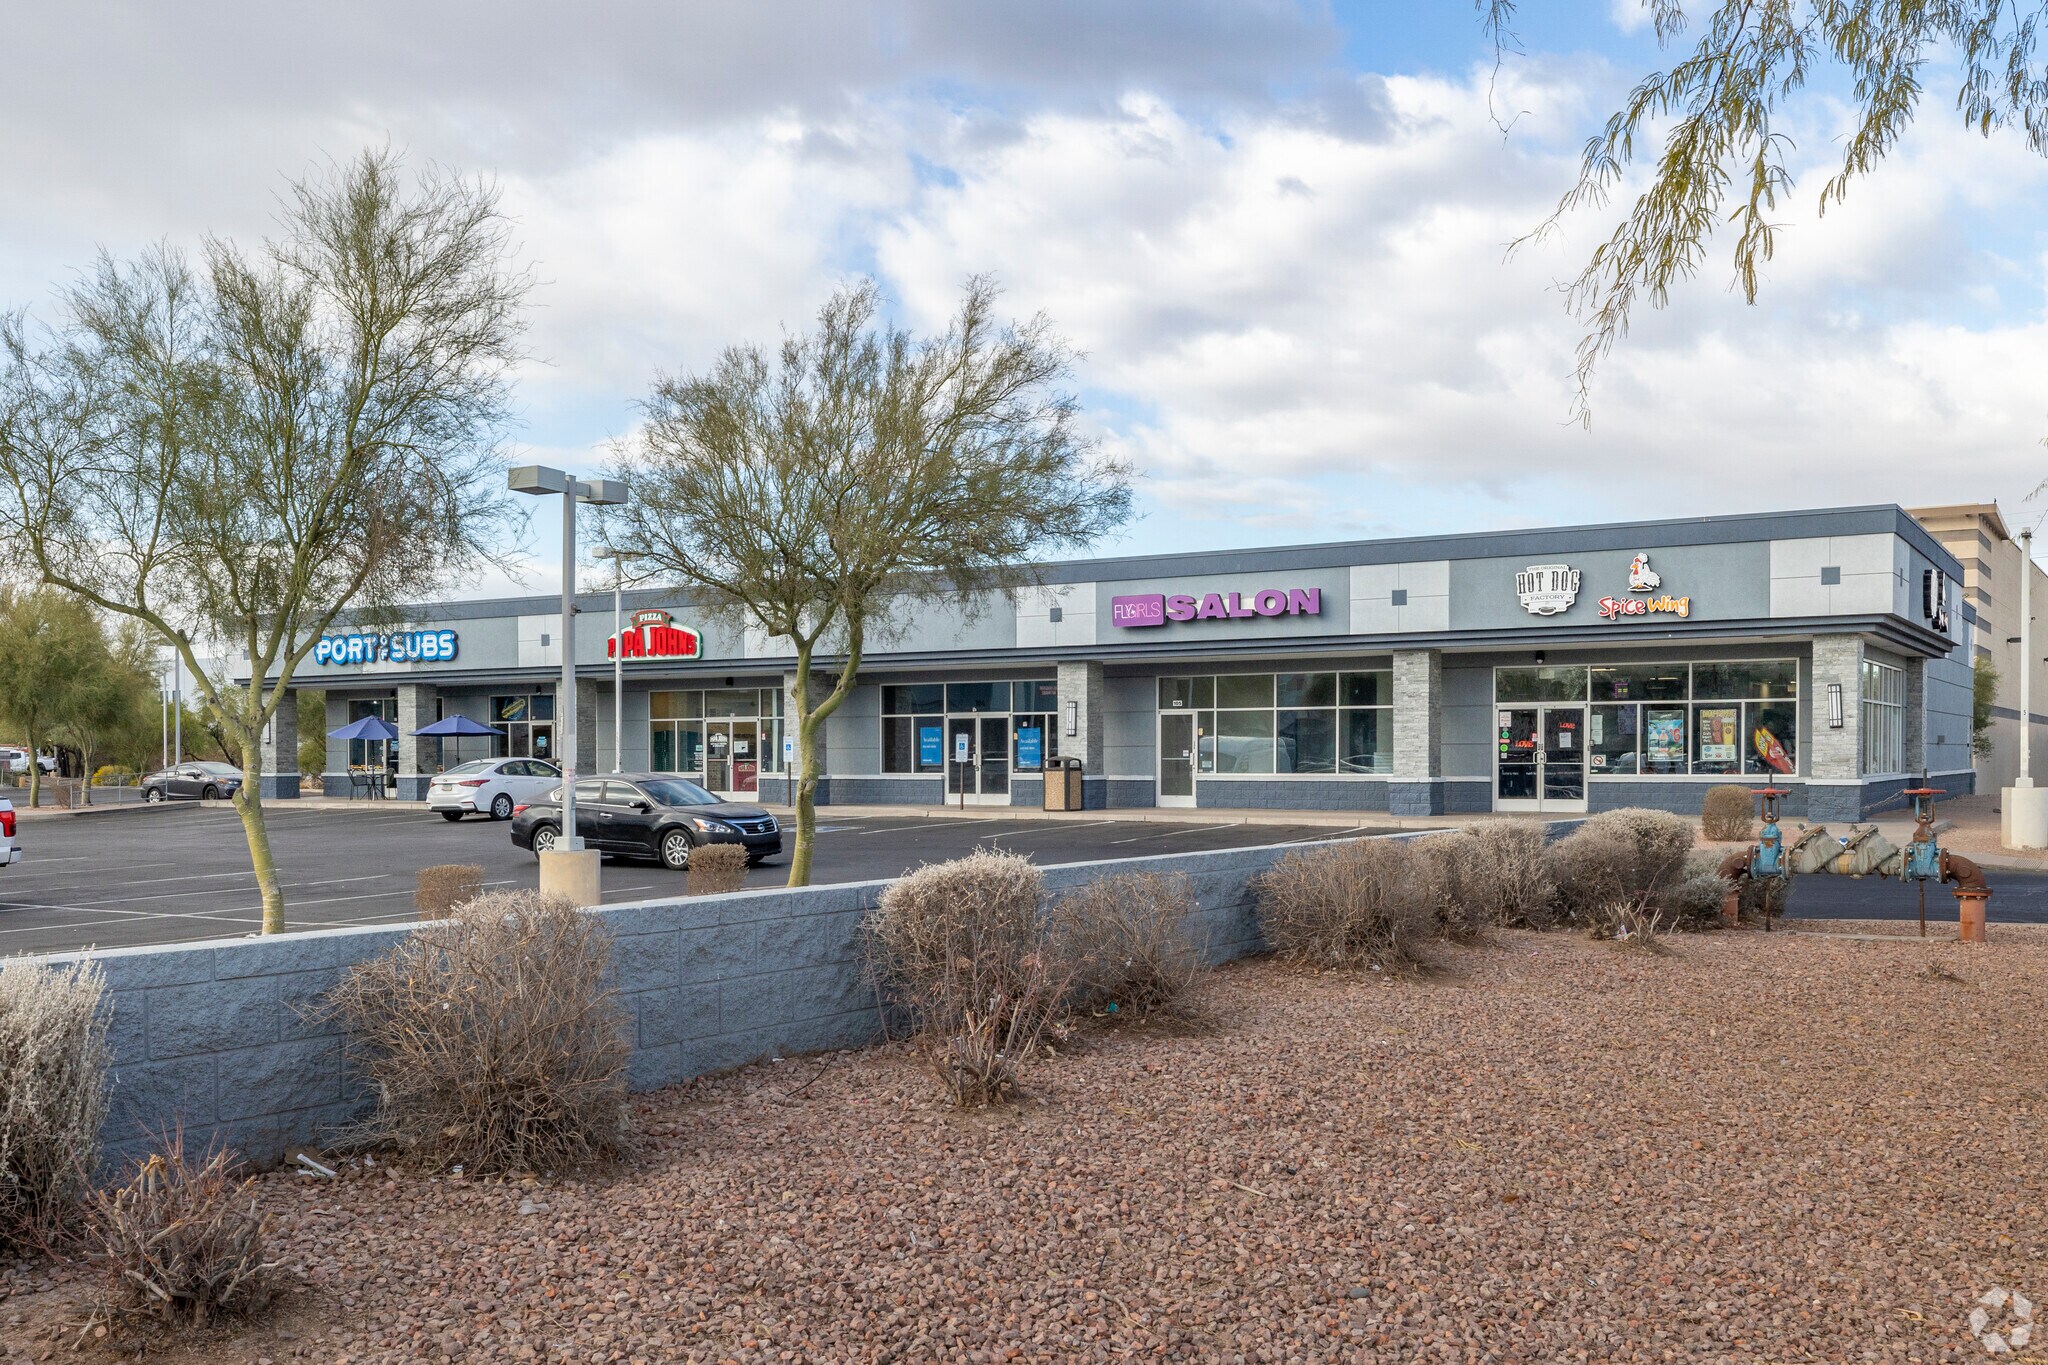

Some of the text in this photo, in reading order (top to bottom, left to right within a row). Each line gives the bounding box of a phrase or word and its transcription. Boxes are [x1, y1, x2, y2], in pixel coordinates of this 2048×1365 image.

[1517, 570, 1578, 594] HOT DOG
[639, 612, 662, 622] PIZZA
[1167, 588, 1321, 621] SALON
[1598, 595, 1690, 620] Spice Wing
[314, 634, 378, 665] PORT
[389, 629, 459, 662] SUBS
[607, 625, 698, 658] PPA JOHNS
